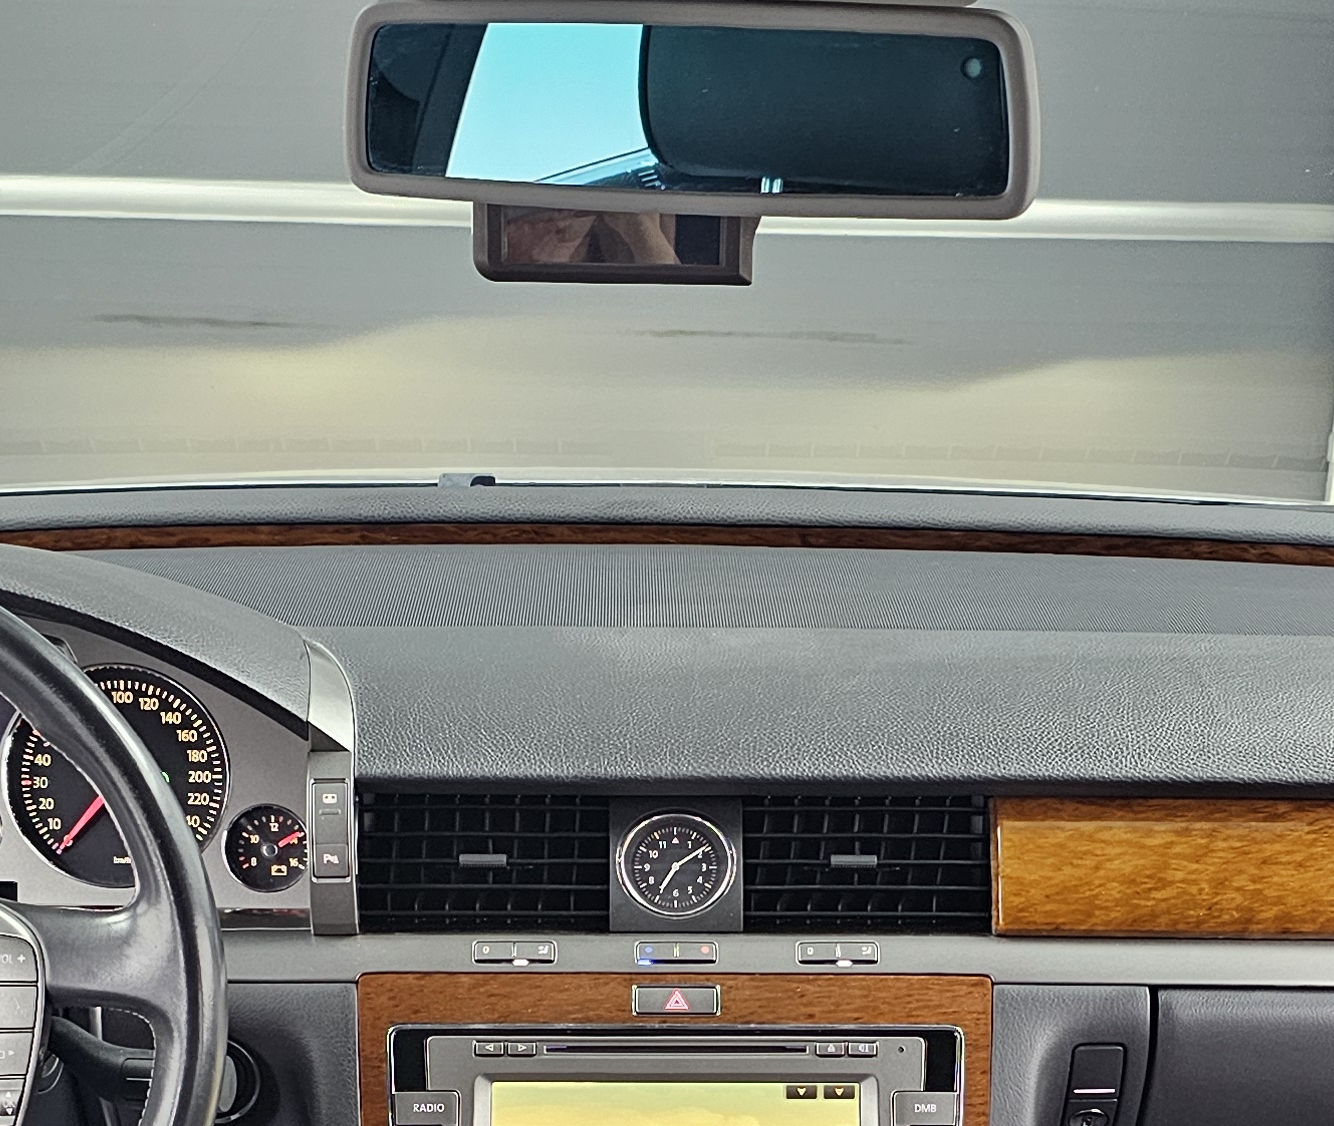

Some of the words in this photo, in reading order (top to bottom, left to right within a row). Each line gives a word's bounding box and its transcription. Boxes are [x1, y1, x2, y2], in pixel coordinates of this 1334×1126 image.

[111, 691, 133, 703] 100
[139, 698, 159, 710] 120
[160, 712, 182, 724] 140
[176, 730, 198, 742] 160
[34, 754, 51, 766] 40
[187, 750, 207, 762] 180
[188, 771, 212, 783] 200
[32, 777, 48, 788] 30
[38, 798, 54, 810] 20
[187, 793, 210, 805] 220
[47, 817, 61, 830] 10
[269, 822, 279, 832] 12
[249, 834, 260, 843] 10
[659, 841, 667, 849] 11
[688, 841, 692, 849] 1
[649, 850, 658, 858] 10
[250, 857, 257, 867] 8
[289, 858, 299, 867] 16
[644, 863, 651, 872] 9
[702, 863, 707, 872] 3
[649, 876, 655, 885] 8
[697, 876, 703, 884] 4
[673, 889, 680, 897] 6
[688, 886, 693, 895] 5
[413, 1103, 445, 1113] RADIO
[914, 1104, 937, 1113] DMB
